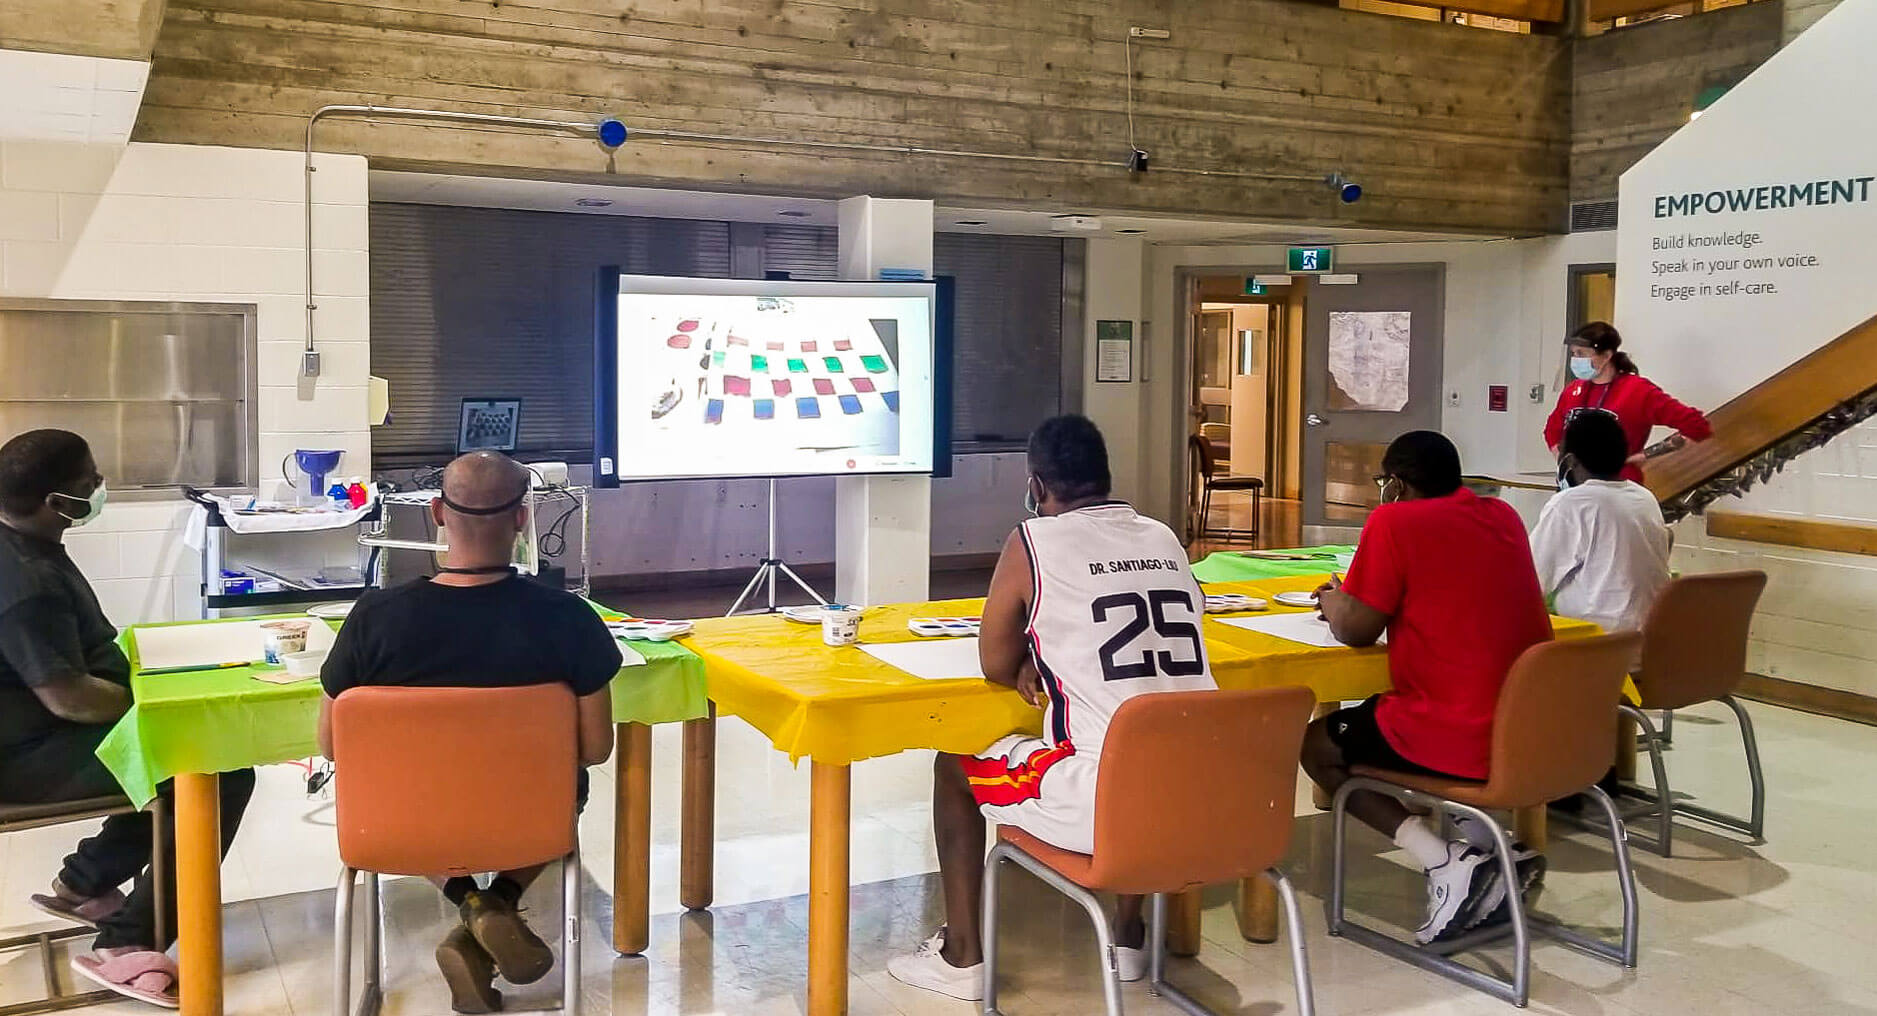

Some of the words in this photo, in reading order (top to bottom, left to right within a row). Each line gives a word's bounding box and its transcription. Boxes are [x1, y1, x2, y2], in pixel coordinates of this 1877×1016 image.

[1654, 176, 1875, 218] EMPOWERMENT
[1652, 235, 1684, 250] Build
[1688, 230, 1764, 249] knowledge.
[1651, 259, 1689, 277] Speak
[1692, 258, 1704, 271] in
[1708, 259, 1740, 275] your
[1743, 258, 1773, 270] own
[1777, 253, 1820, 268] voice.
[1651, 283, 1696, 301] Engage
[1700, 282, 1711, 296] in
[1715, 280, 1779, 296] self-care.
[1089, 563, 1109, 575] DR.
[1091, 589, 1204, 682] 25
